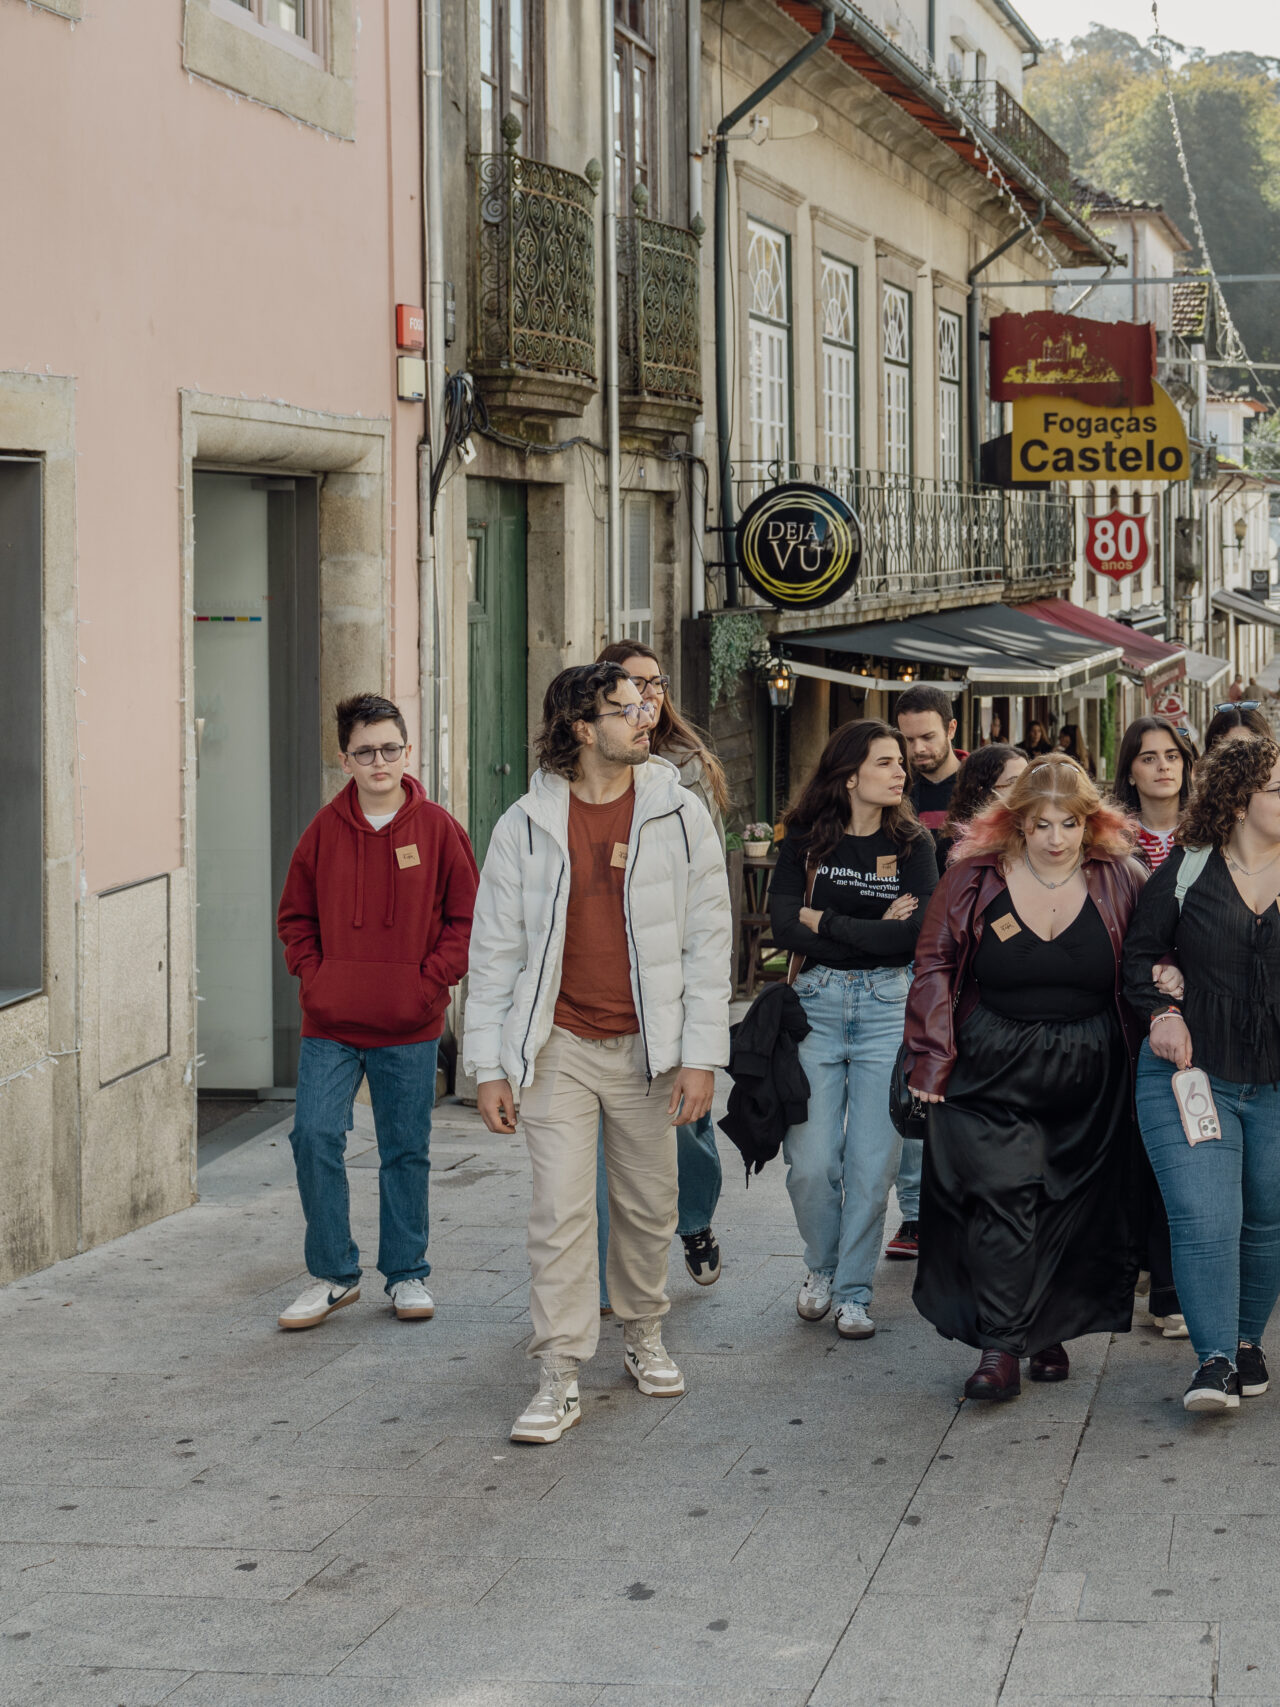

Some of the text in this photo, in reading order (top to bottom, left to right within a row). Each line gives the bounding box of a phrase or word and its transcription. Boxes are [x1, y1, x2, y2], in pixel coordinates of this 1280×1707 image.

[1043, 412, 1158, 439] Fogaças
[1019, 438, 1184, 473] Castelo
[1093, 519, 1141, 561] 80
[768, 540, 824, 572] VU
[1101, 560, 1134, 571] anos
[830, 866, 862, 879] pasa
[848, 879, 868, 888] when
[869, 883, 900, 891] everythin
